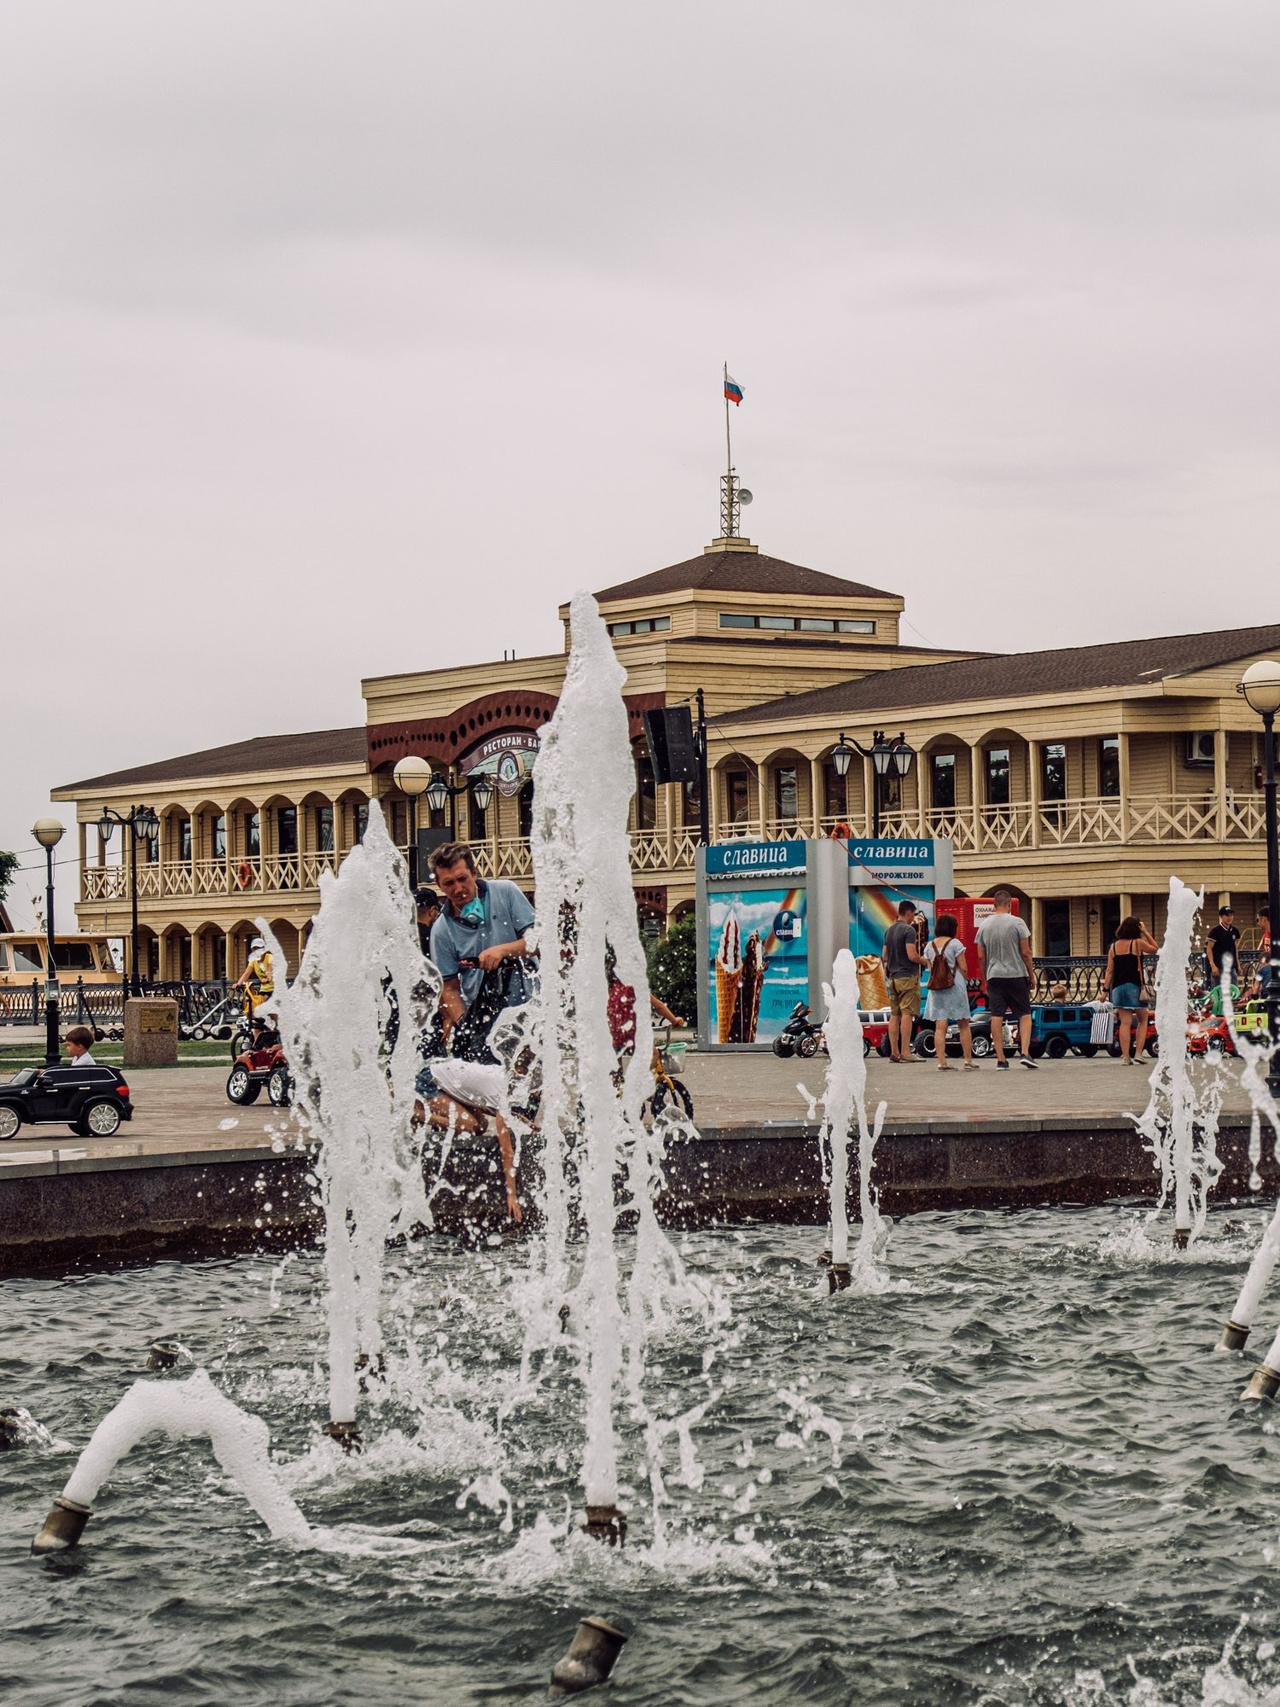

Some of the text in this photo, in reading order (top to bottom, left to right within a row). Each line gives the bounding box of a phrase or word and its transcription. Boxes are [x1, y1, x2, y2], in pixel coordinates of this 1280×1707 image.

[483, 737, 522, 756] РЕСТОРАН
[723, 846, 787, 866] славица
[853, 846, 928, 859] славица
